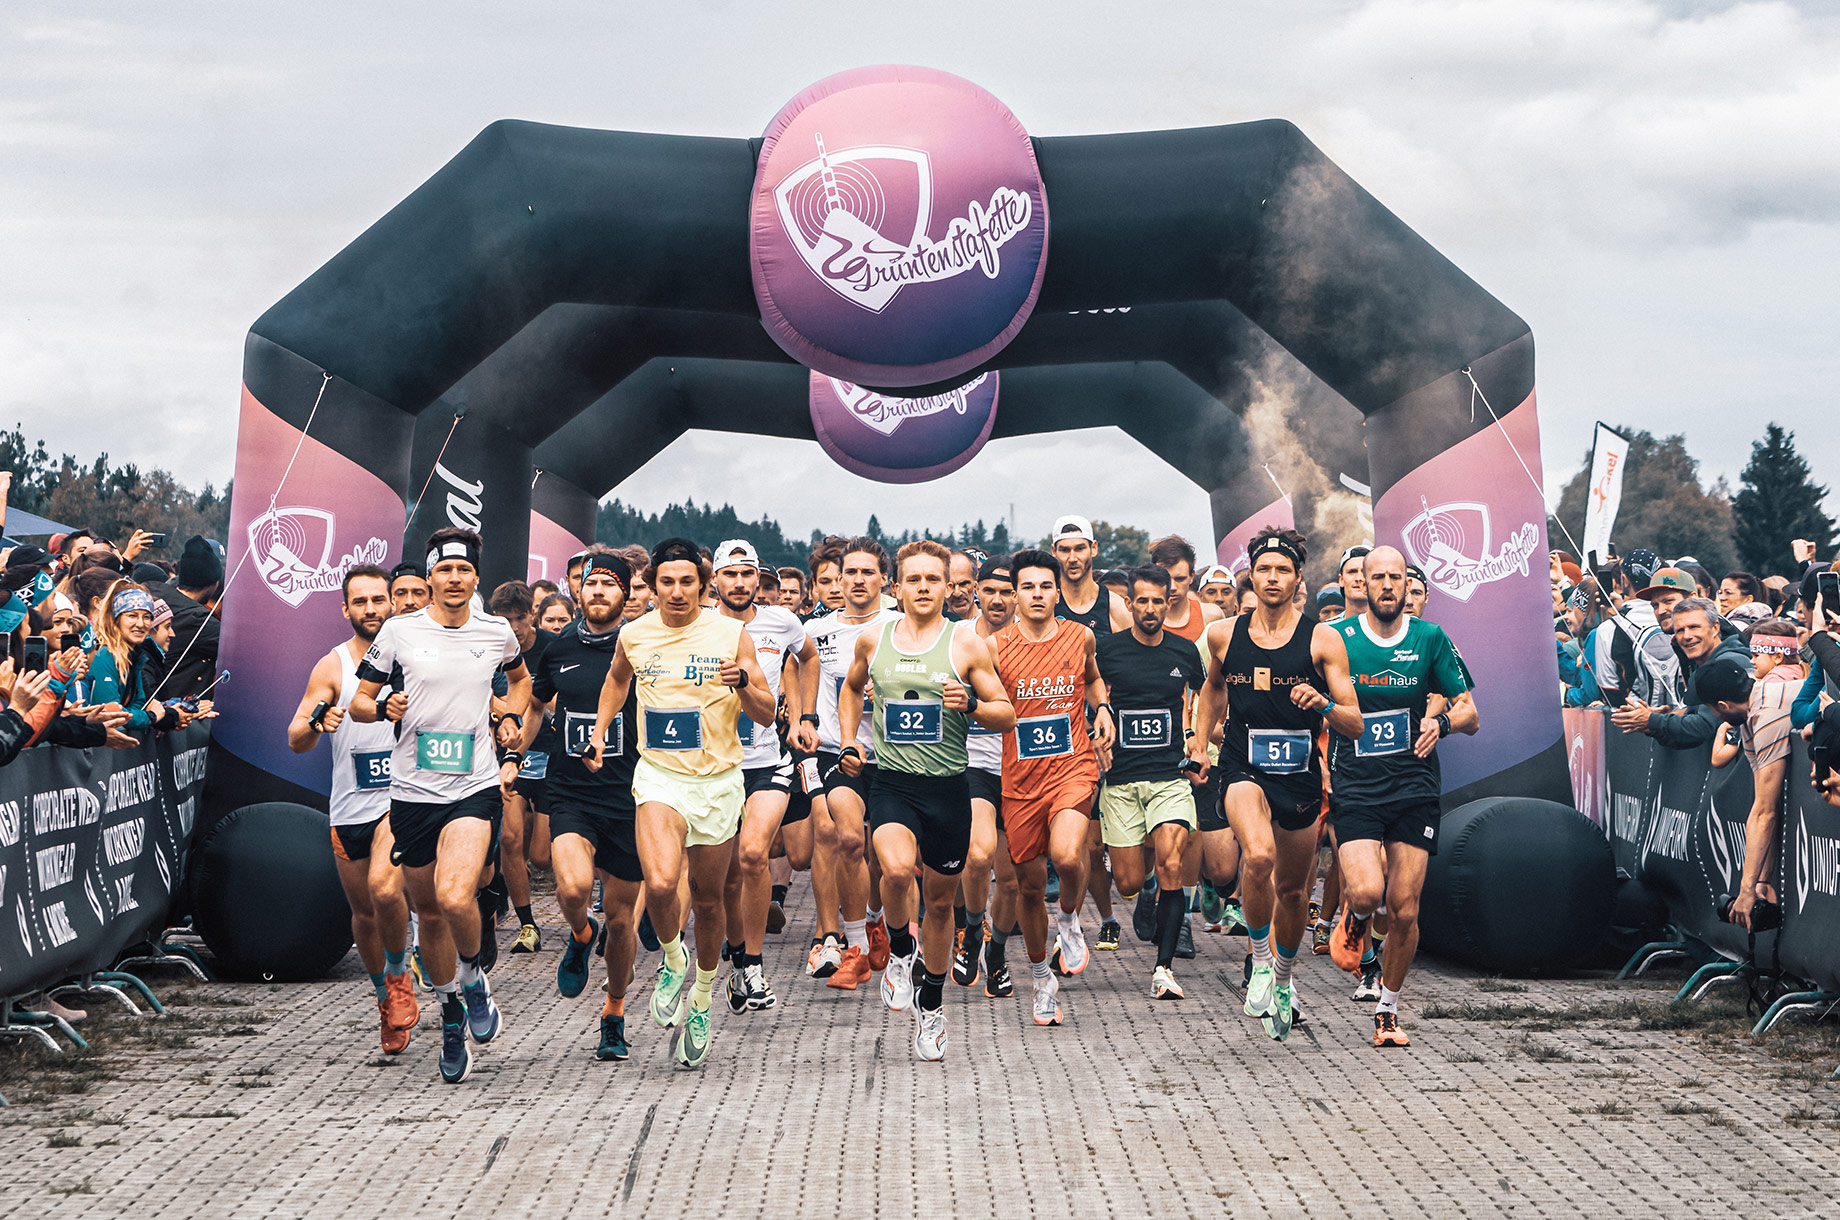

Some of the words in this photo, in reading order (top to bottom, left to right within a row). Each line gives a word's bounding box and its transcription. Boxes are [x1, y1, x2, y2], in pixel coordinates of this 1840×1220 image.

[843, 194, 1027, 291] Grüntenstafette
[689, 654, 721, 663] Team
[1018, 675, 1075, 688] SPORT
[1017, 685, 1075, 697] HASCHKO
[1046, 698, 1074, 710] Team
[665, 719, 678, 737] 4
[900, 711, 924, 729] 32
[1131, 719, 1161, 735] 153
[1033, 726, 1056, 744] 36
[1371, 722, 1395, 740] 93
[426, 739, 462, 759] 301
[1268, 742, 1290, 760] 51
[369, 758, 391, 776] 58
[523, 755, 531, 767] 6
